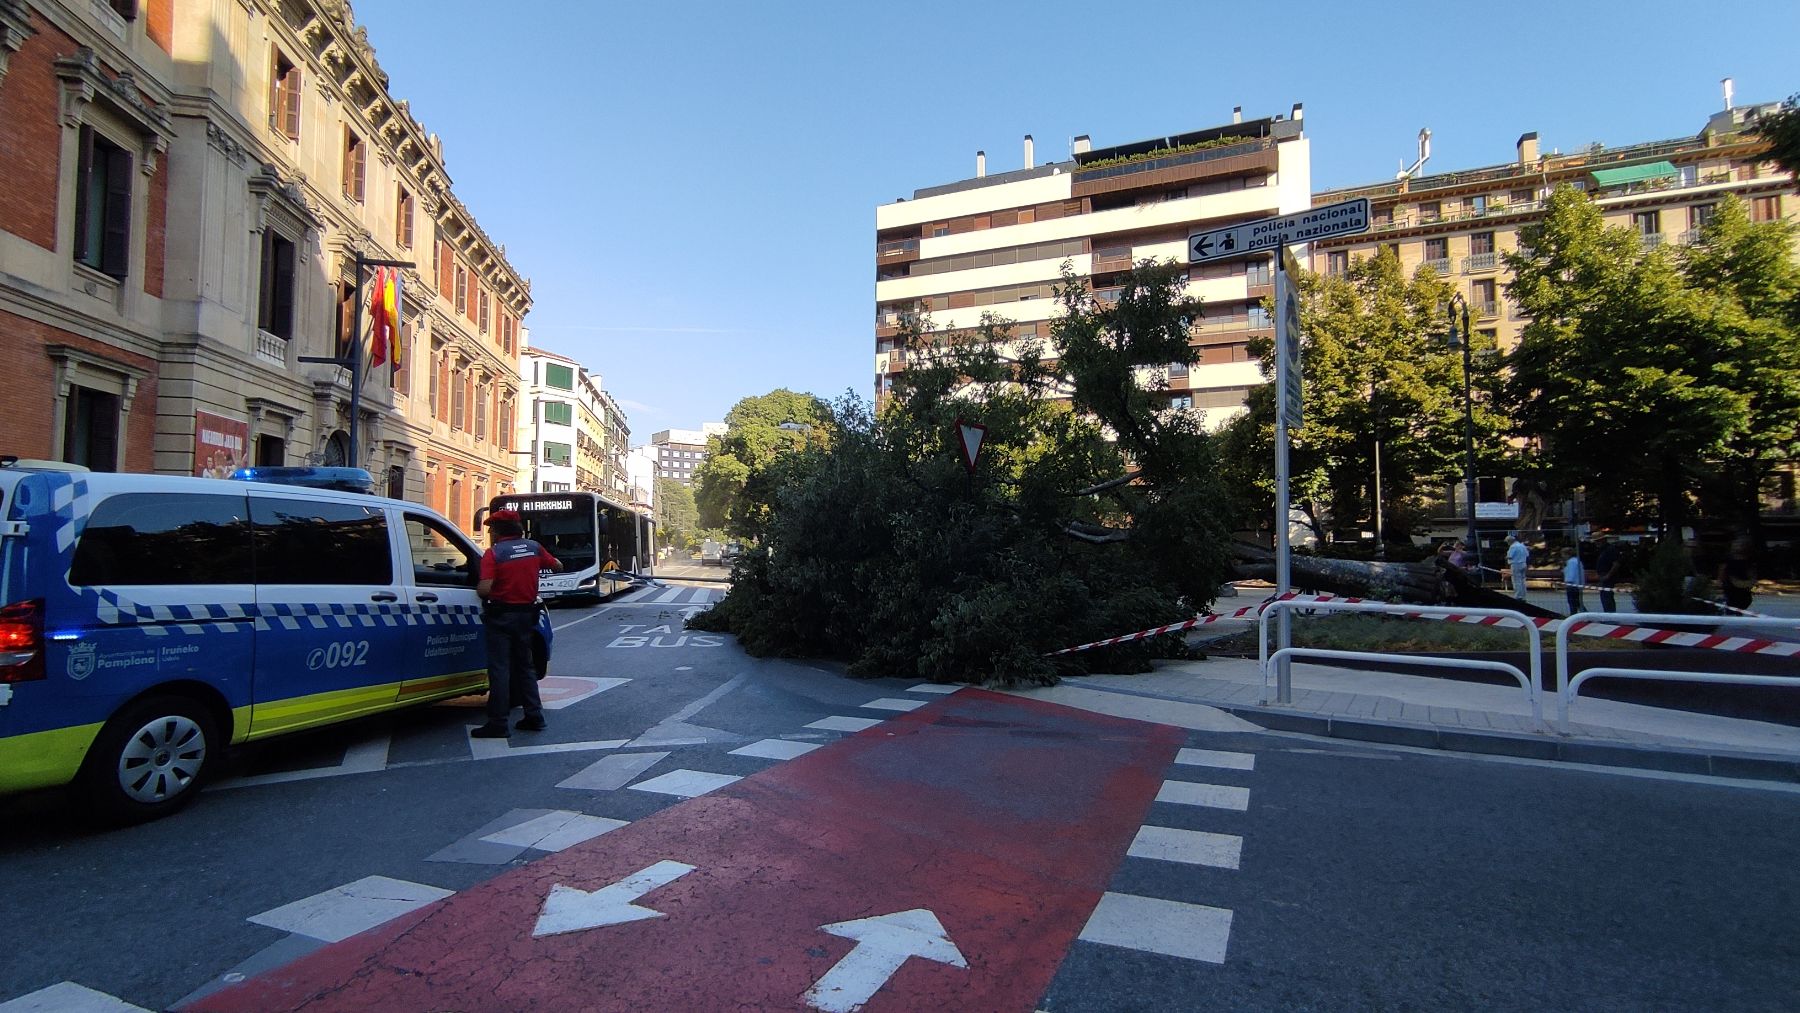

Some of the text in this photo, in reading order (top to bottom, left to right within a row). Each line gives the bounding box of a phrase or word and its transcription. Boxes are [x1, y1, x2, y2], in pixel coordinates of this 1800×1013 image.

[1302, 203, 1363, 225] nacional
[1248, 218, 1362, 250] polizia nazionala
[161, 643, 200, 656] Iruñeko
[605, 635, 725, 648] BUS
[97, 655, 156, 669] Pamplona
[326, 640, 370, 669] 092
